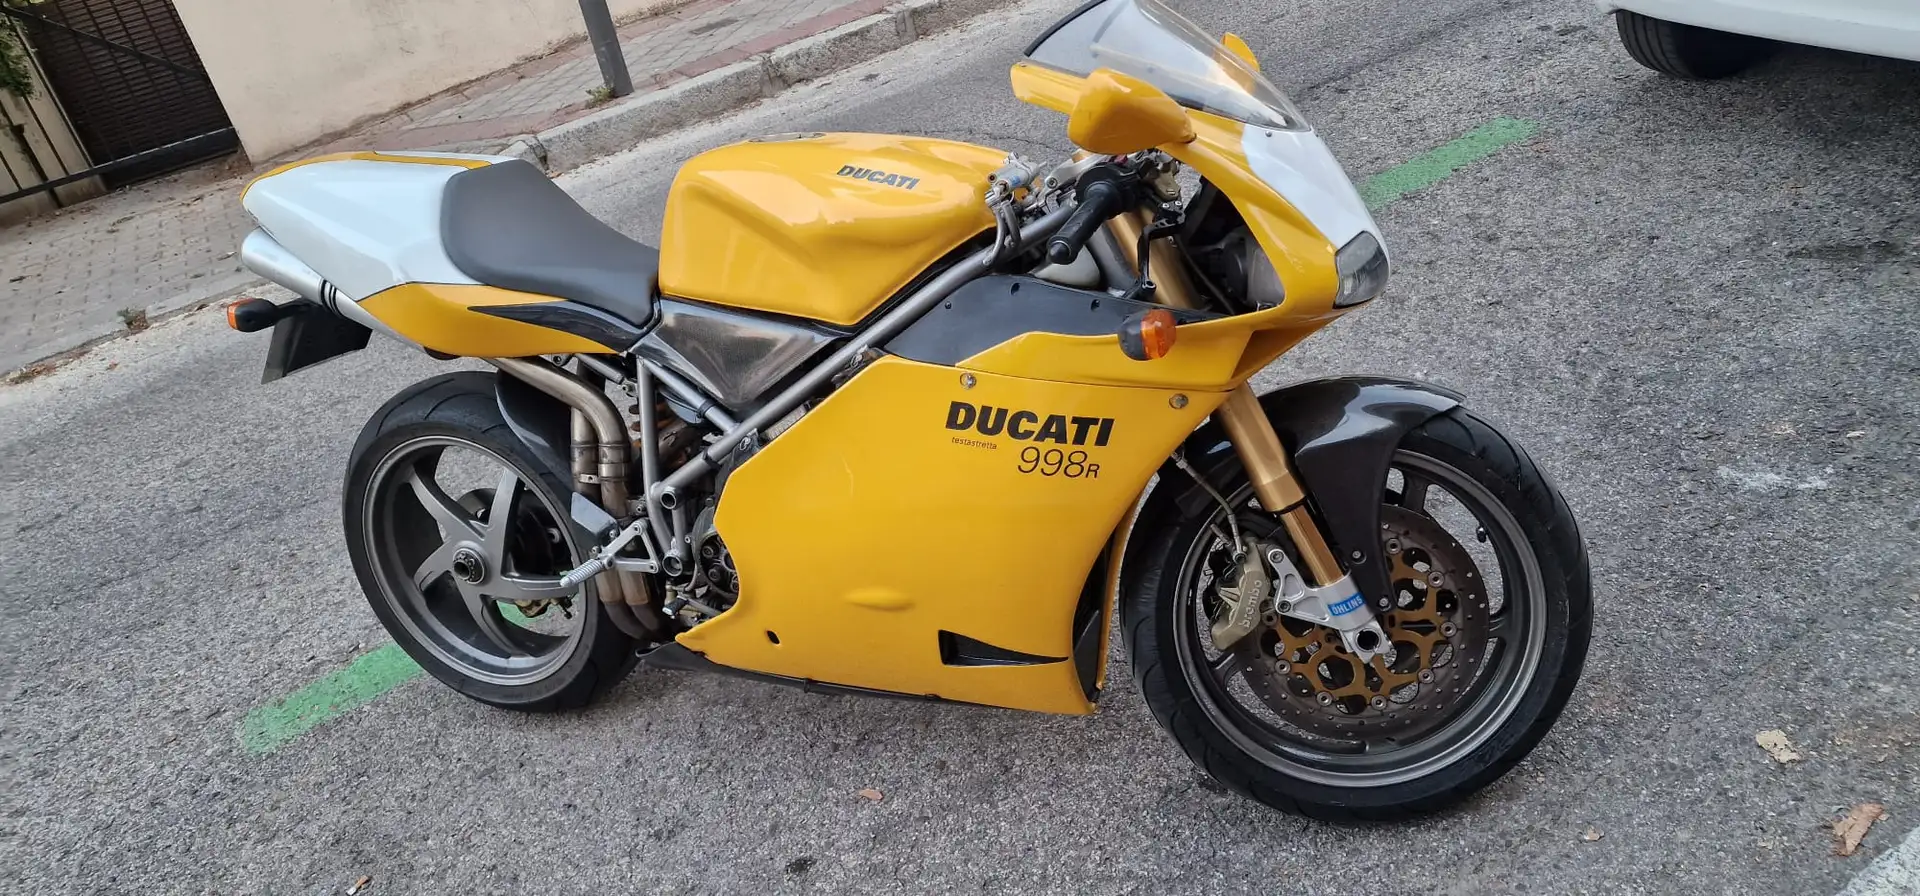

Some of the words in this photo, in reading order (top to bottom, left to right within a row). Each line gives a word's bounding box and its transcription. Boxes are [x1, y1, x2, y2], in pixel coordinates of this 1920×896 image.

[836, 165, 920, 190] DUCATI
[945, 401, 1115, 446] DUCATI
[951, 437, 997, 450] testastretta
[1238, 580, 1262, 628] brembo
